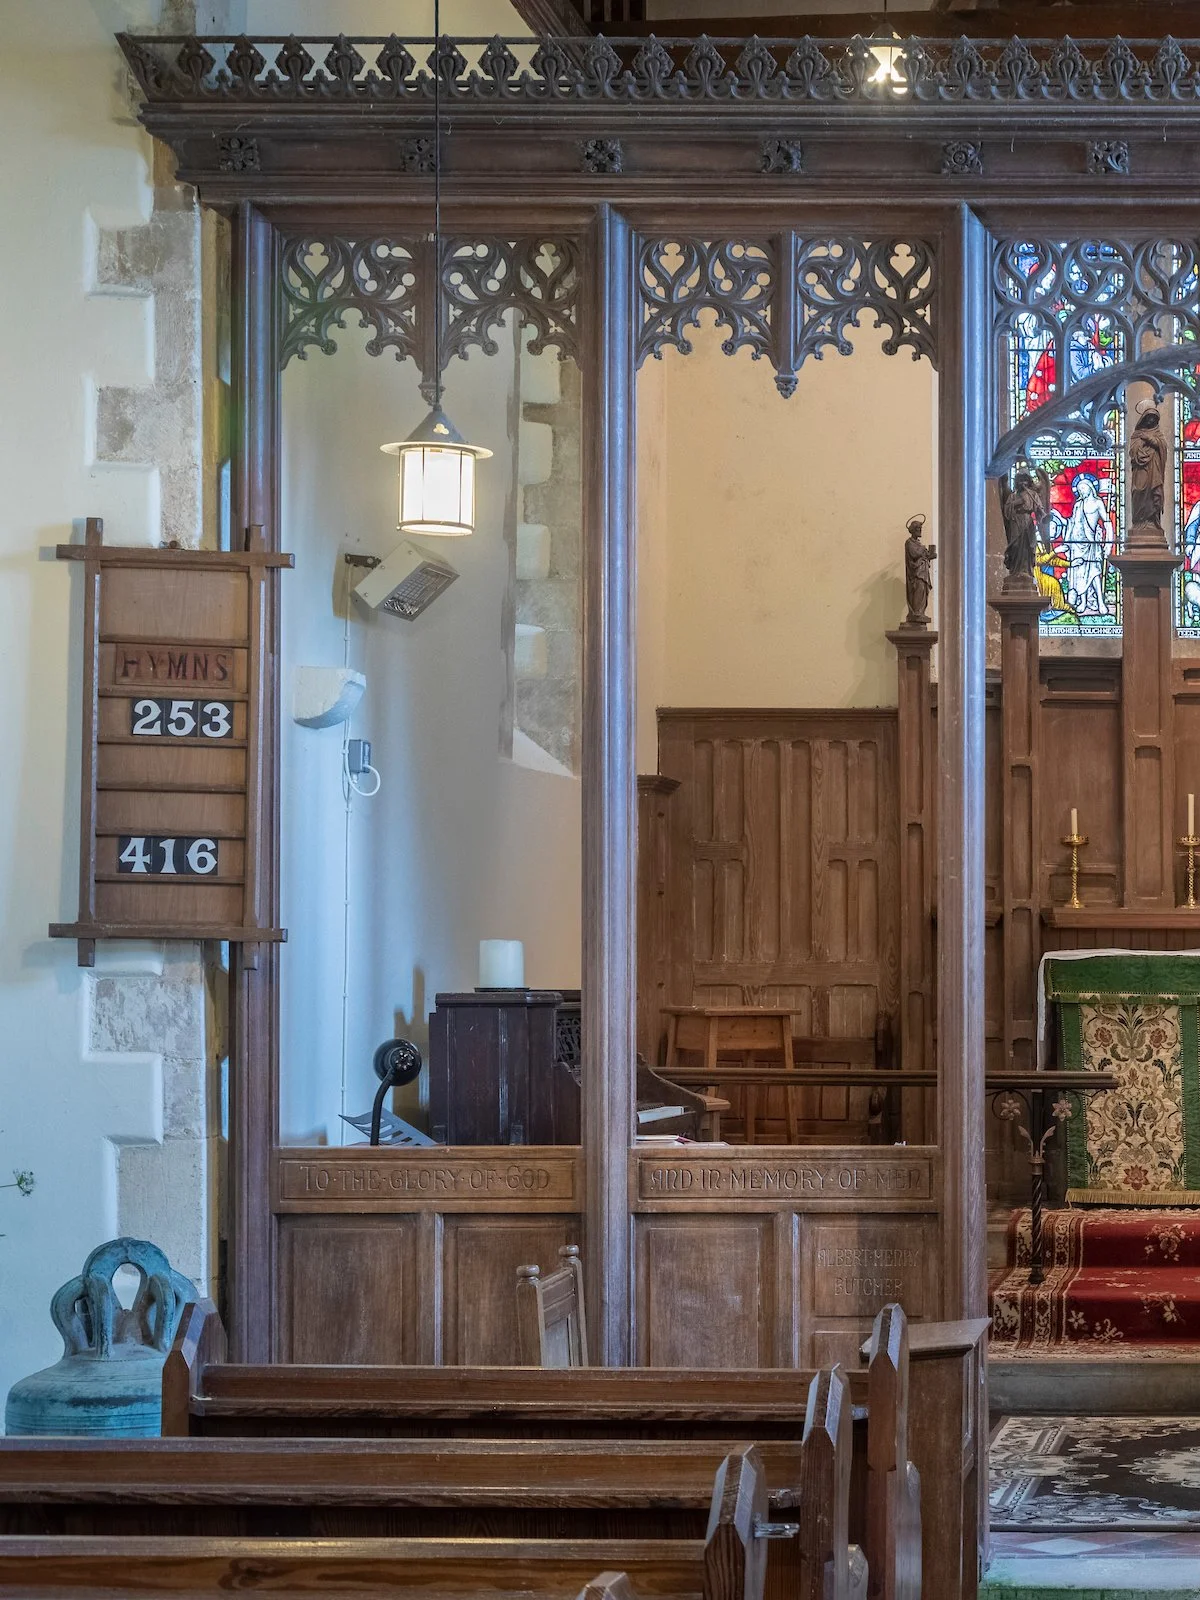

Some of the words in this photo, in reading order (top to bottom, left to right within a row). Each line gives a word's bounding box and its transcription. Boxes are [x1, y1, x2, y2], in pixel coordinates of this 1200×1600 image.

[121, 650, 229, 682] HYMNS
[132, 699, 232, 738] 253
[119, 837, 218, 874] 416
[338, 1169, 382, 1191] THE
[388, 1169, 462, 1191] GLORY
[468, 1169, 496, 1191] OF
[650, 1168, 693, 1191] AND
[699, 1168, 721, 1190] IN
[728, 1168, 829, 1191] MEMORY
[838, 1168, 865, 1191] OF
[873, 1168, 921, 1190] MEN
[817, 1248, 870, 1267] ALBERT
[873, 1248, 919, 1267] HENRY
[834, 1277, 904, 1296] BUTCHER
